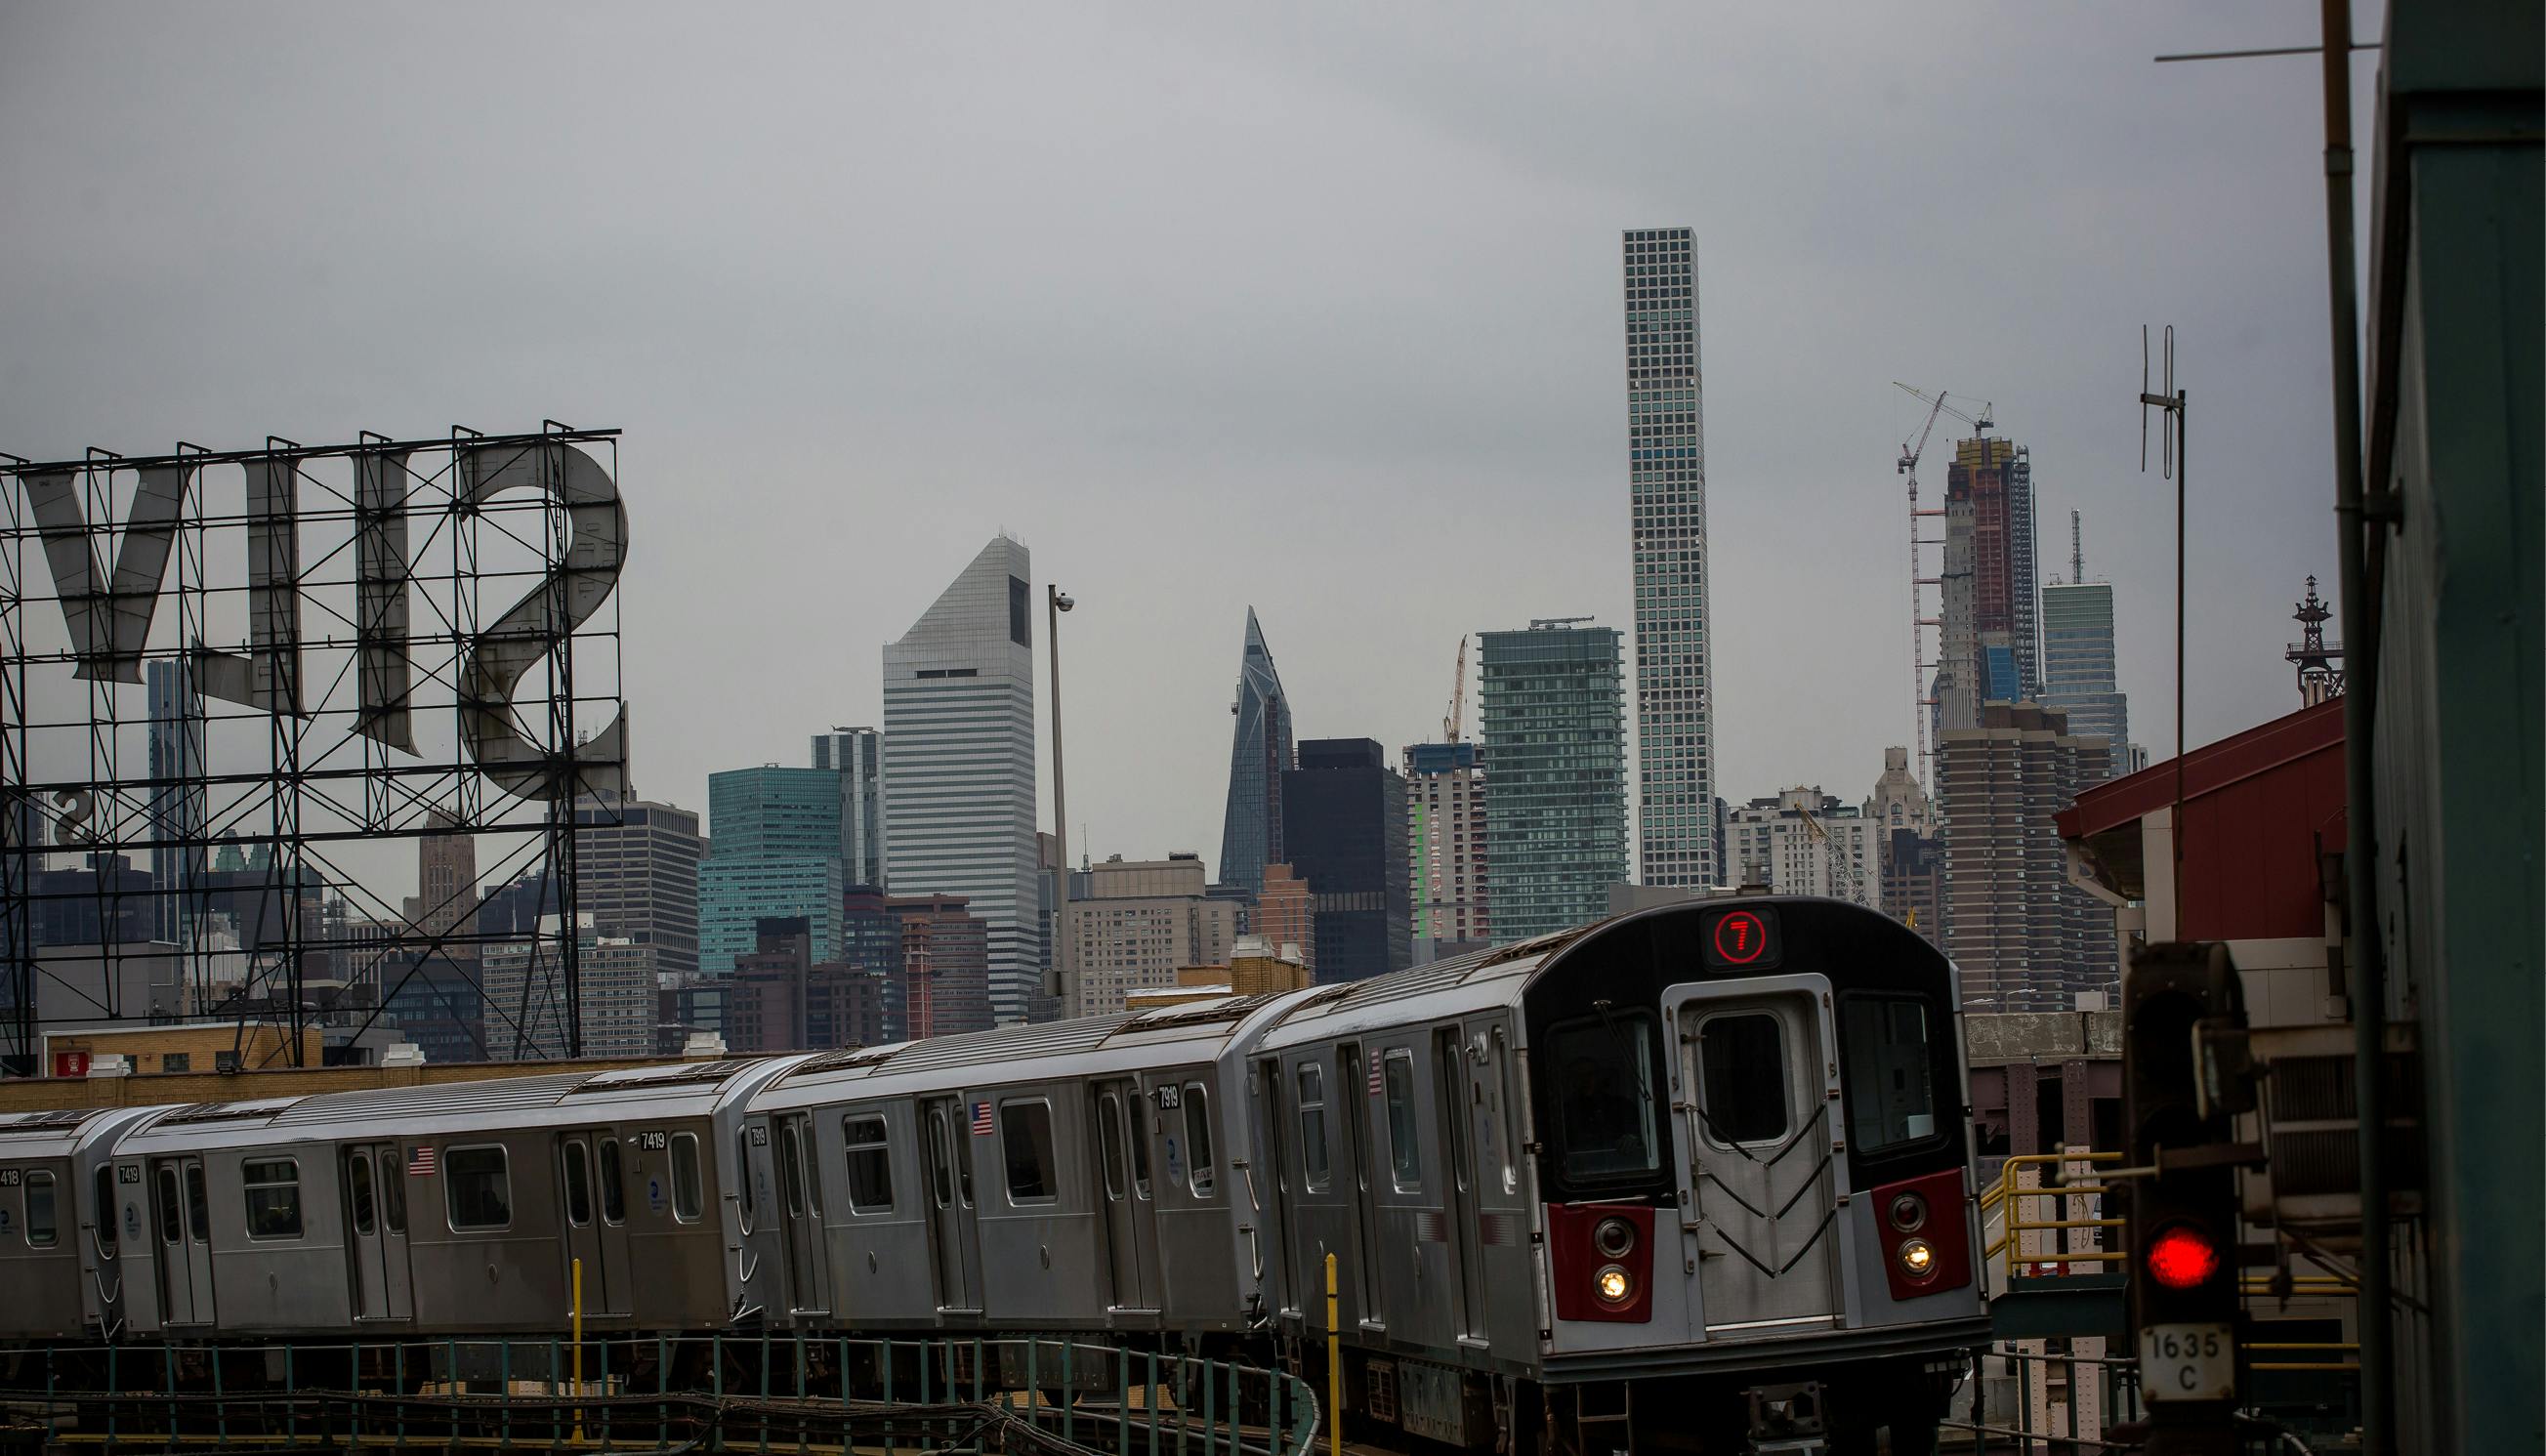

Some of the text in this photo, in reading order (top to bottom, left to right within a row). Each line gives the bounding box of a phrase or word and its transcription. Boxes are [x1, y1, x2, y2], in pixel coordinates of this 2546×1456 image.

[1729, 921, 1749, 951] 7
[1159, 1086, 1179, 1108] 7919
[642, 1133, 665, 1149] 7419
[0, 1170, 20, 1186] 418
[119, 1167, 139, 1183] 7419
[2153, 1333, 2219, 1359] 1635
[2179, 1365, 2196, 1391] C
